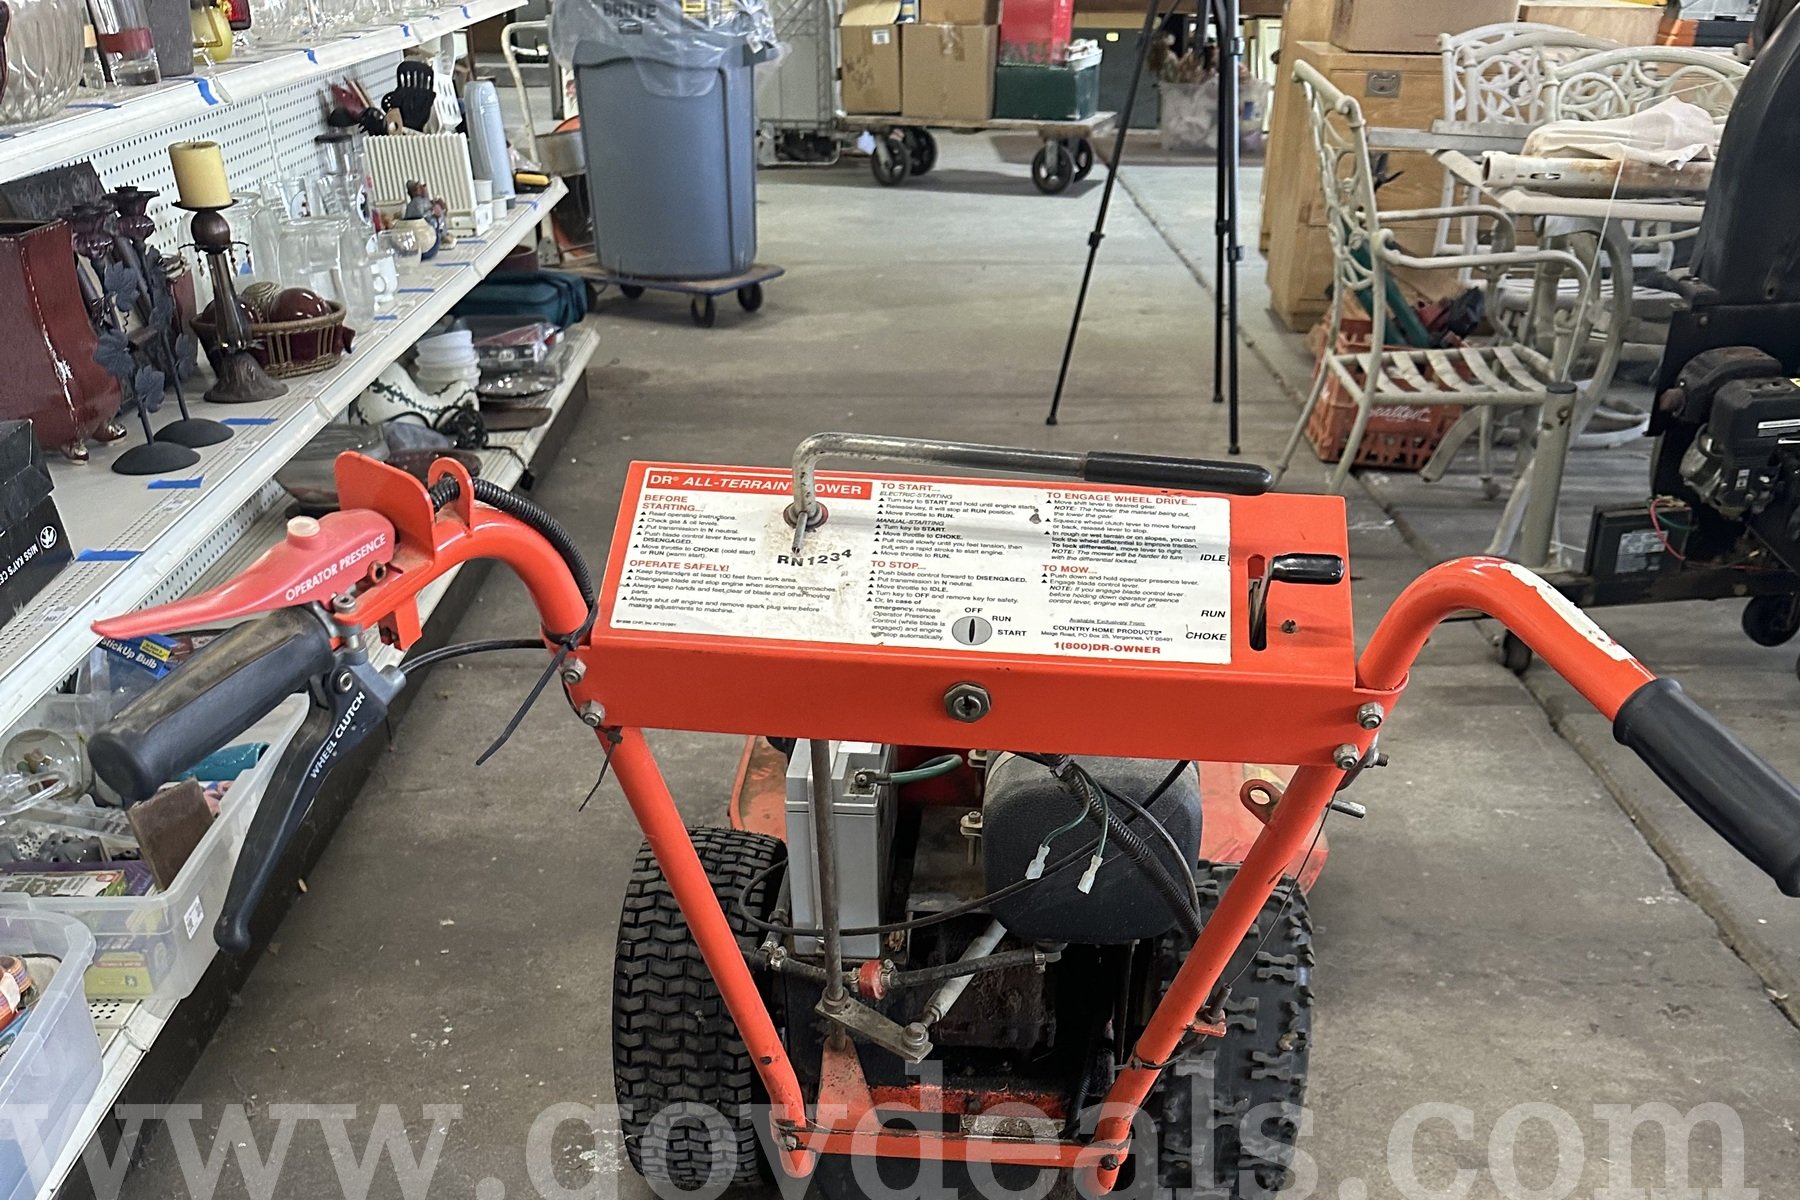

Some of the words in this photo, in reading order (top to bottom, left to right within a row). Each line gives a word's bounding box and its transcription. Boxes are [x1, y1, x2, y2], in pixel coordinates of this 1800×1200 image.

[814, 483, 862, 495] OWER
[644, 494, 688, 502] BEFORE
[879, 491, 952, 499] ELECTRIC-STARTING
[1064, 493, 1110, 501] ENGAGE
[1114, 495, 1152, 503] WHEEL
[876, 518, 944, 526] MANUAL-STARTING
[23, 543, 39, 562] MISS
[1200, 554, 1227, 562] IDLE
[7, 556, 25, 576] KAY'S
[285, 563, 338, 601] OPERATOR
[339, 533, 387, 571] PRESENCE
[629, 560, 681, 569] OPERATE
[683, 563, 729, 571] SAFELY!
[1053, 624, 1090, 632] COUNTRY
[1185, 631, 1227, 641] CHOKE
[1054, 641, 1160, 654] 1(800)DR-OWNER
[135, 652, 158, 669] Bulb
[310, 740, 338, 778] WHEEL
[335, 691, 365, 738] CLUTCH
